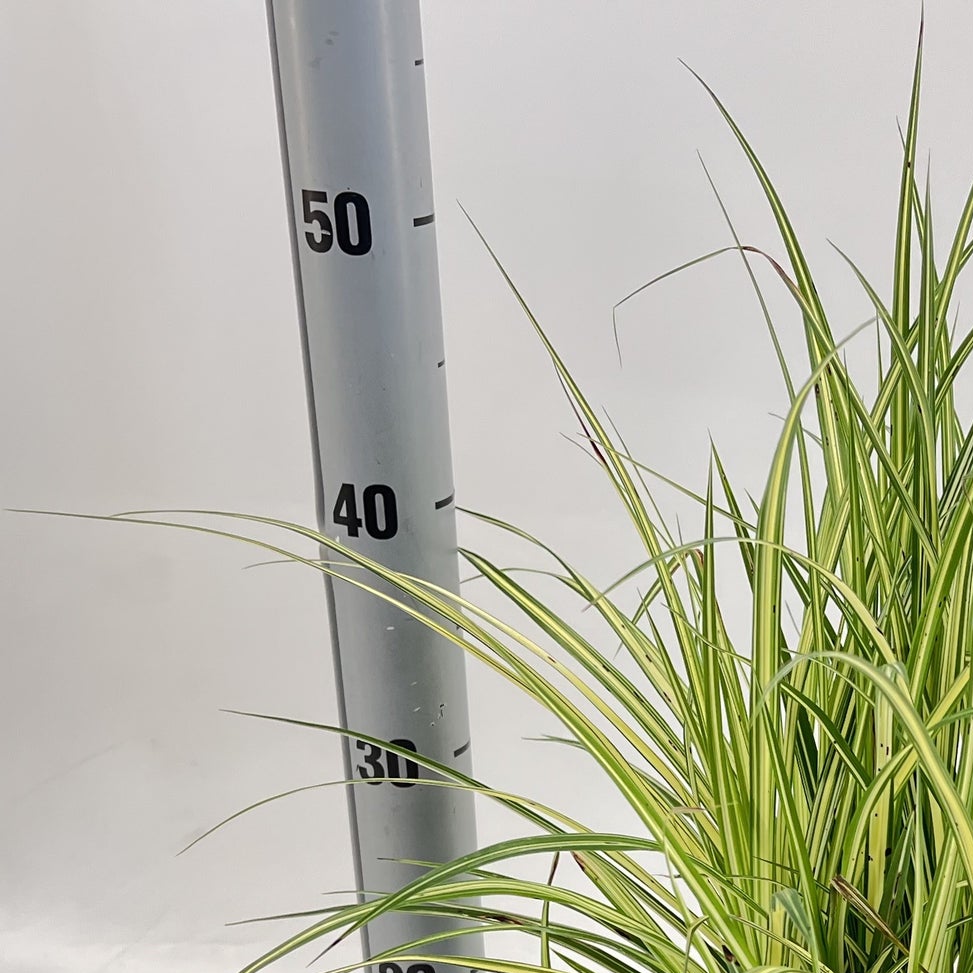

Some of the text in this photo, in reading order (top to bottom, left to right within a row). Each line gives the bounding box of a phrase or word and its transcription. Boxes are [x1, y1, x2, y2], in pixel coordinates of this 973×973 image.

[301, 189, 373, 256] 50
[332, 482, 399, 541] 40
[355, 738, 420, 788] 30
